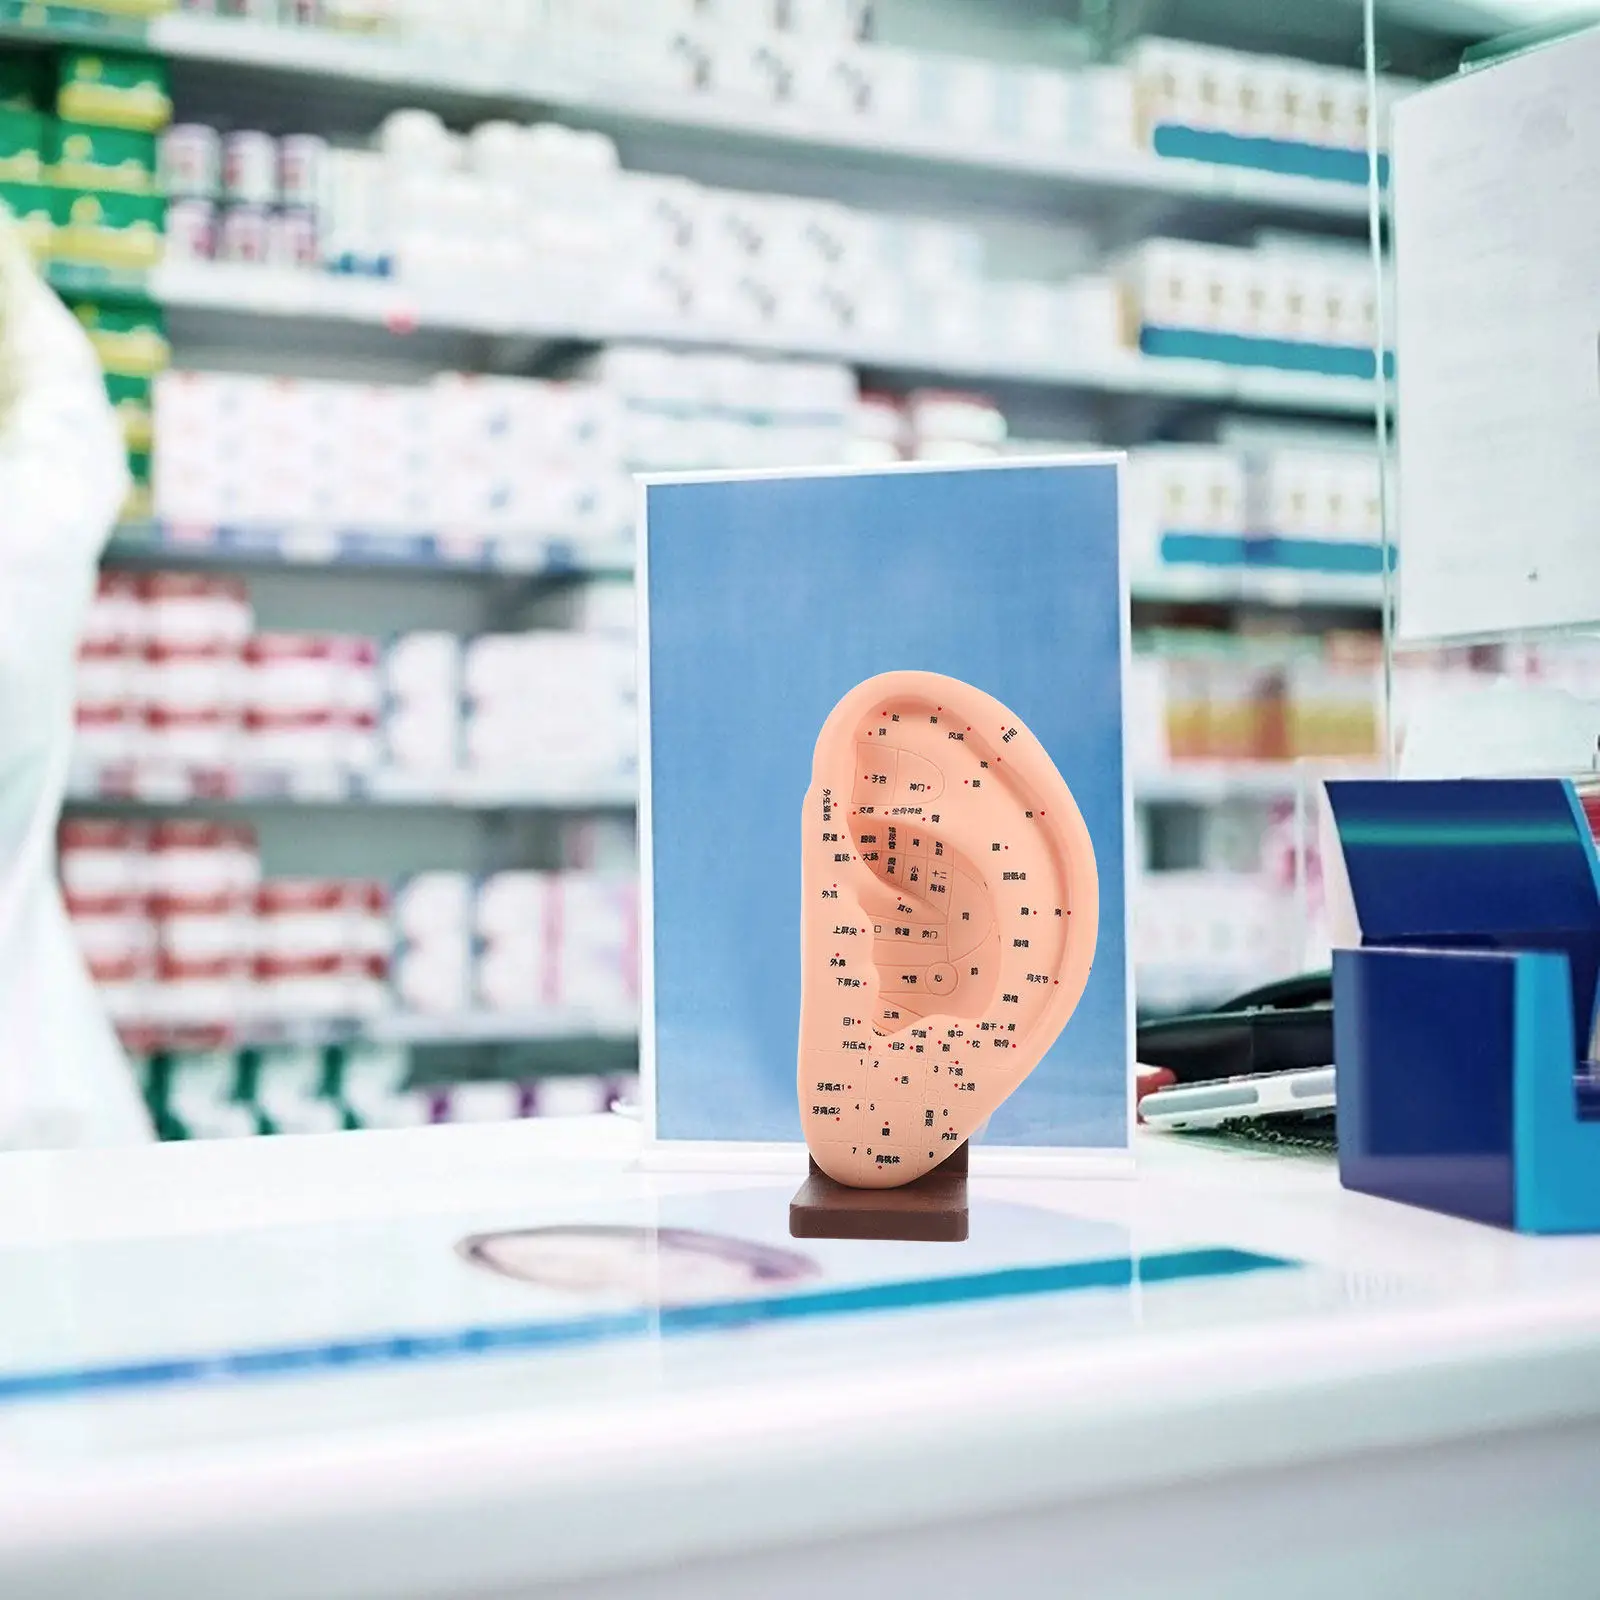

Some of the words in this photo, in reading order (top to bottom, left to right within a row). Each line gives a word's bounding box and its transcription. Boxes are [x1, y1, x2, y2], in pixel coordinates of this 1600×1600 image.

[1002, 728, 1017, 743] 肝阳
[871, 774, 887, 784] 子宫
[910, 783, 925, 792] 神门
[822, 833, 838, 841] 尿道
[834, 854, 850, 862] 直肠
[863, 853, 879, 861] 大肠
[910, 866, 919, 881] 小肠
[932, 870, 947, 879] 十二
[822, 890, 838, 899] 外耳
[897, 904, 913, 914] 耳中
[833, 926, 857, 935] 上屏尖
[830, 958, 846, 967] 外鼻
[836, 978, 860, 987] 下屏尖
[902, 975, 917, 983] 气管
[883, 1011, 899, 1019] 三焦
[843, 1017, 855, 1026] 目1
[842, 1041, 866, 1050] 升压点
[892, 1042, 905, 1050] 目2
[817, 1083, 844, 1091] 牙痛点1
[812, 1106, 840, 1115] 牙痛点2
[942, 1133, 958, 1141] 内耳
